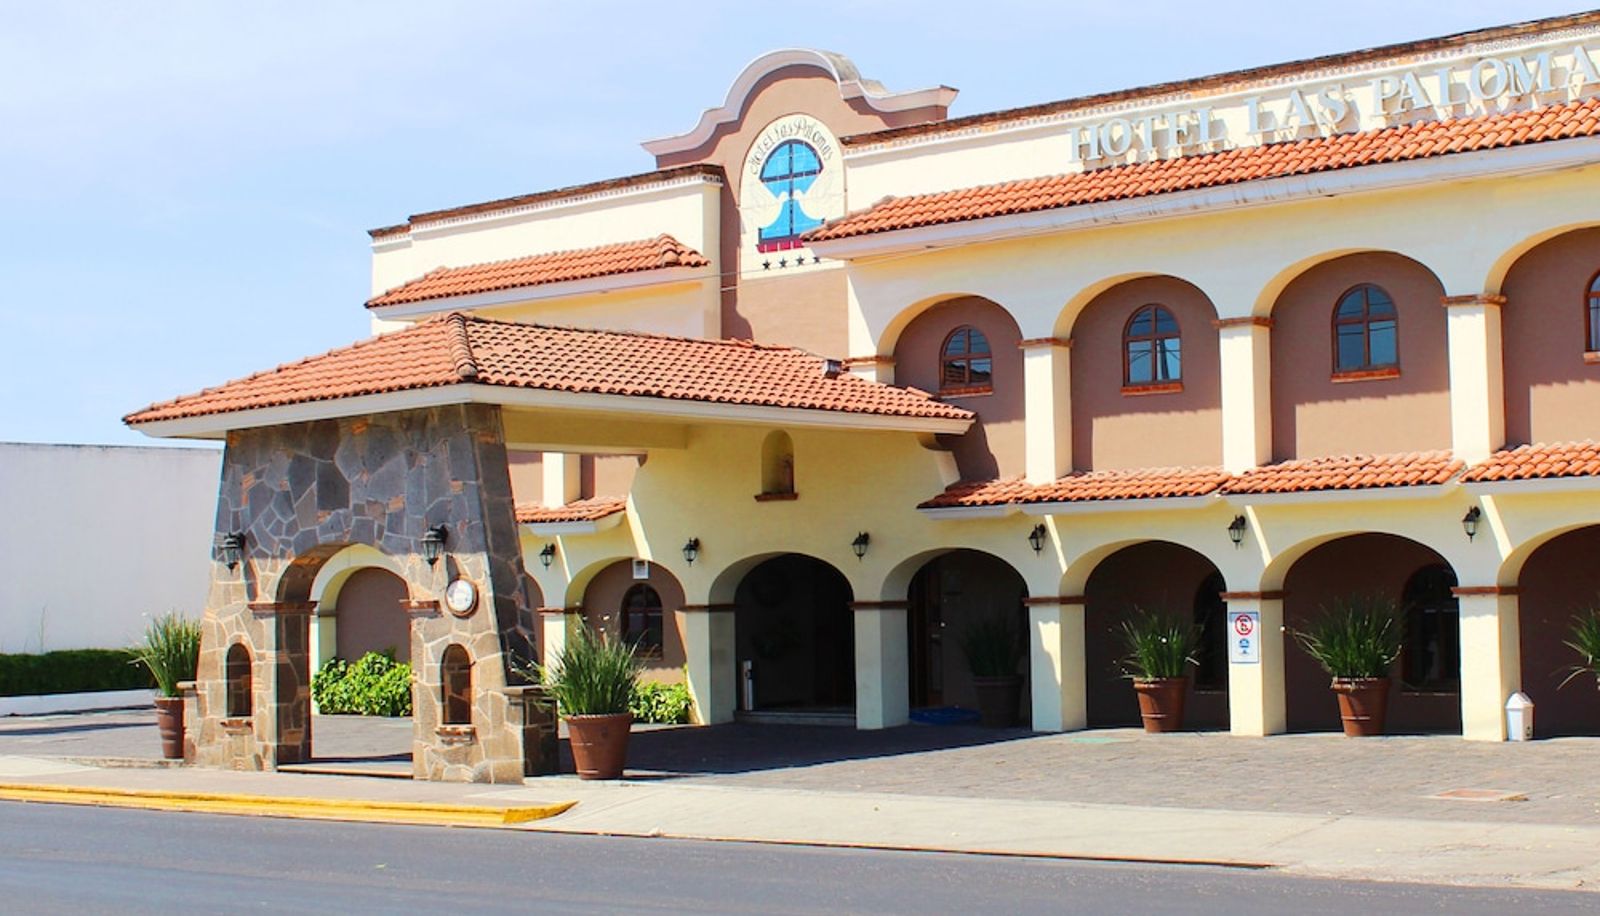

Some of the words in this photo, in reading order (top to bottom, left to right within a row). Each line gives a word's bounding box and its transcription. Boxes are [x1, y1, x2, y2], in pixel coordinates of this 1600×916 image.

[1068, 107, 1226, 163] HOTEL
[1244, 83, 1346, 134] LAS
[748, 133, 776, 175] Hotel
